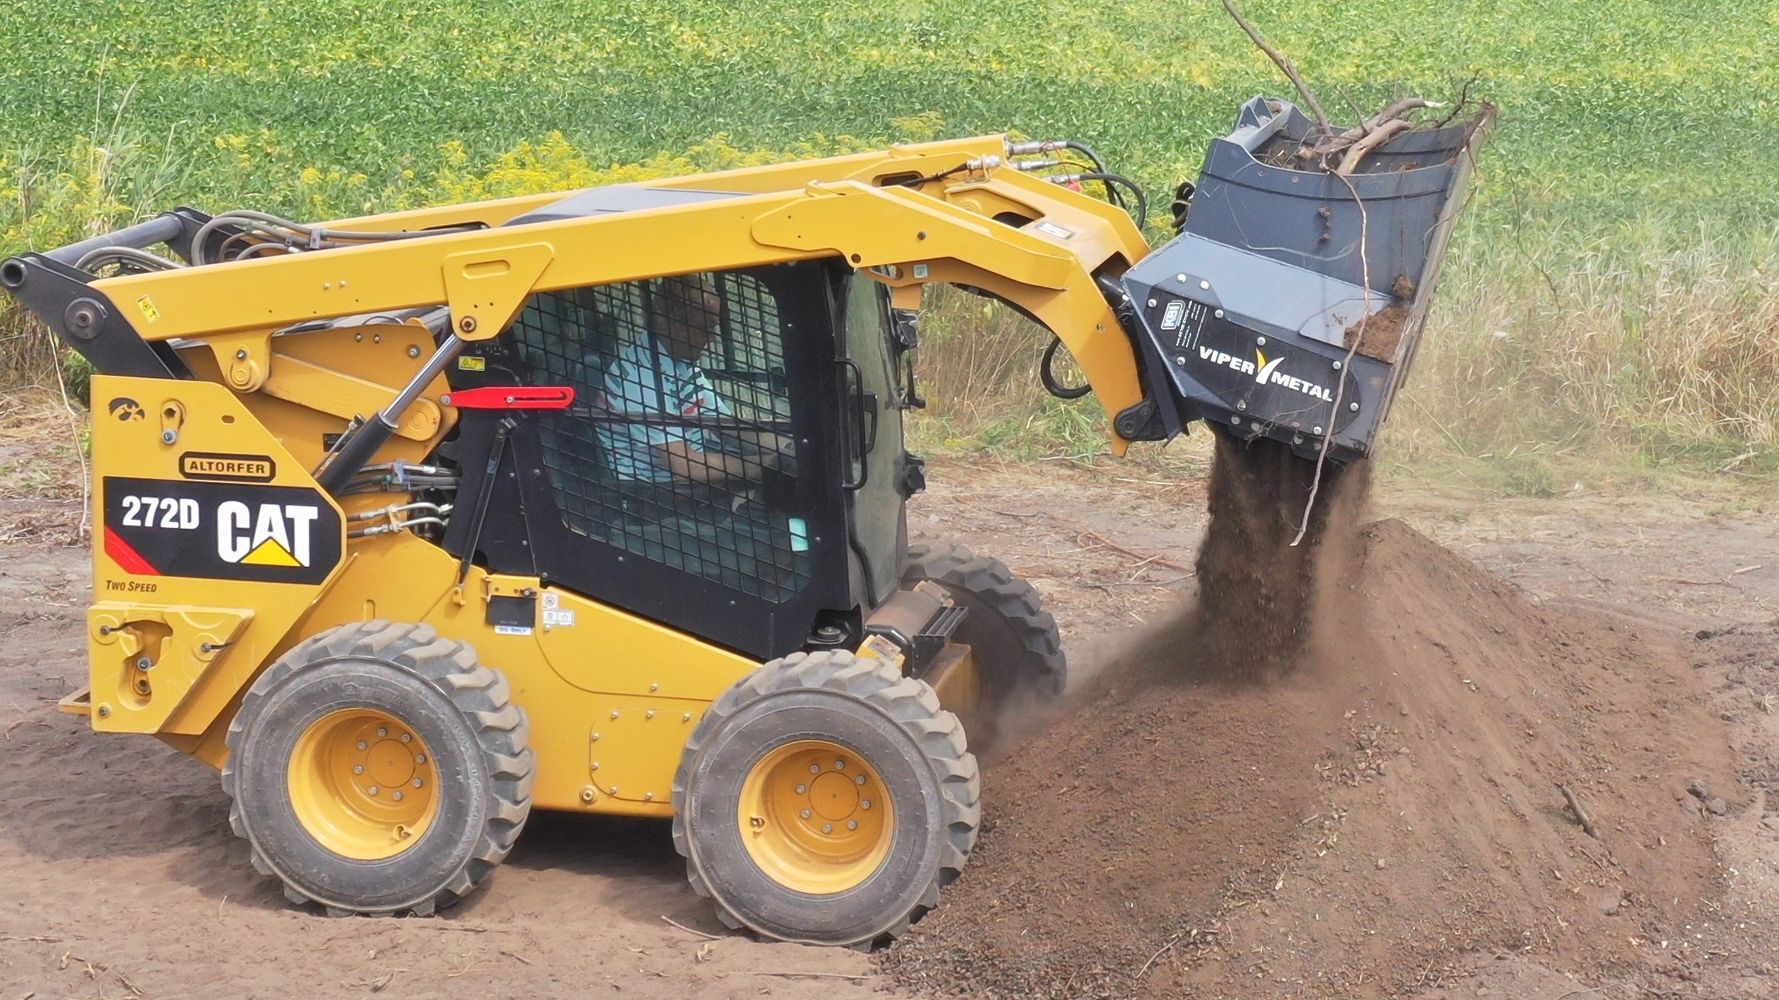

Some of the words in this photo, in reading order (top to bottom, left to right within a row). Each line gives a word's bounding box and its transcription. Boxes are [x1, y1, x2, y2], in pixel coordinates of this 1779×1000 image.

[1200, 345, 1254, 376] VIPER
[1271, 371, 1333, 402] METAL
[189, 461, 266, 475] ALTORFER
[121, 495, 200, 530] 272D
[217, 500, 319, 568] CAT
